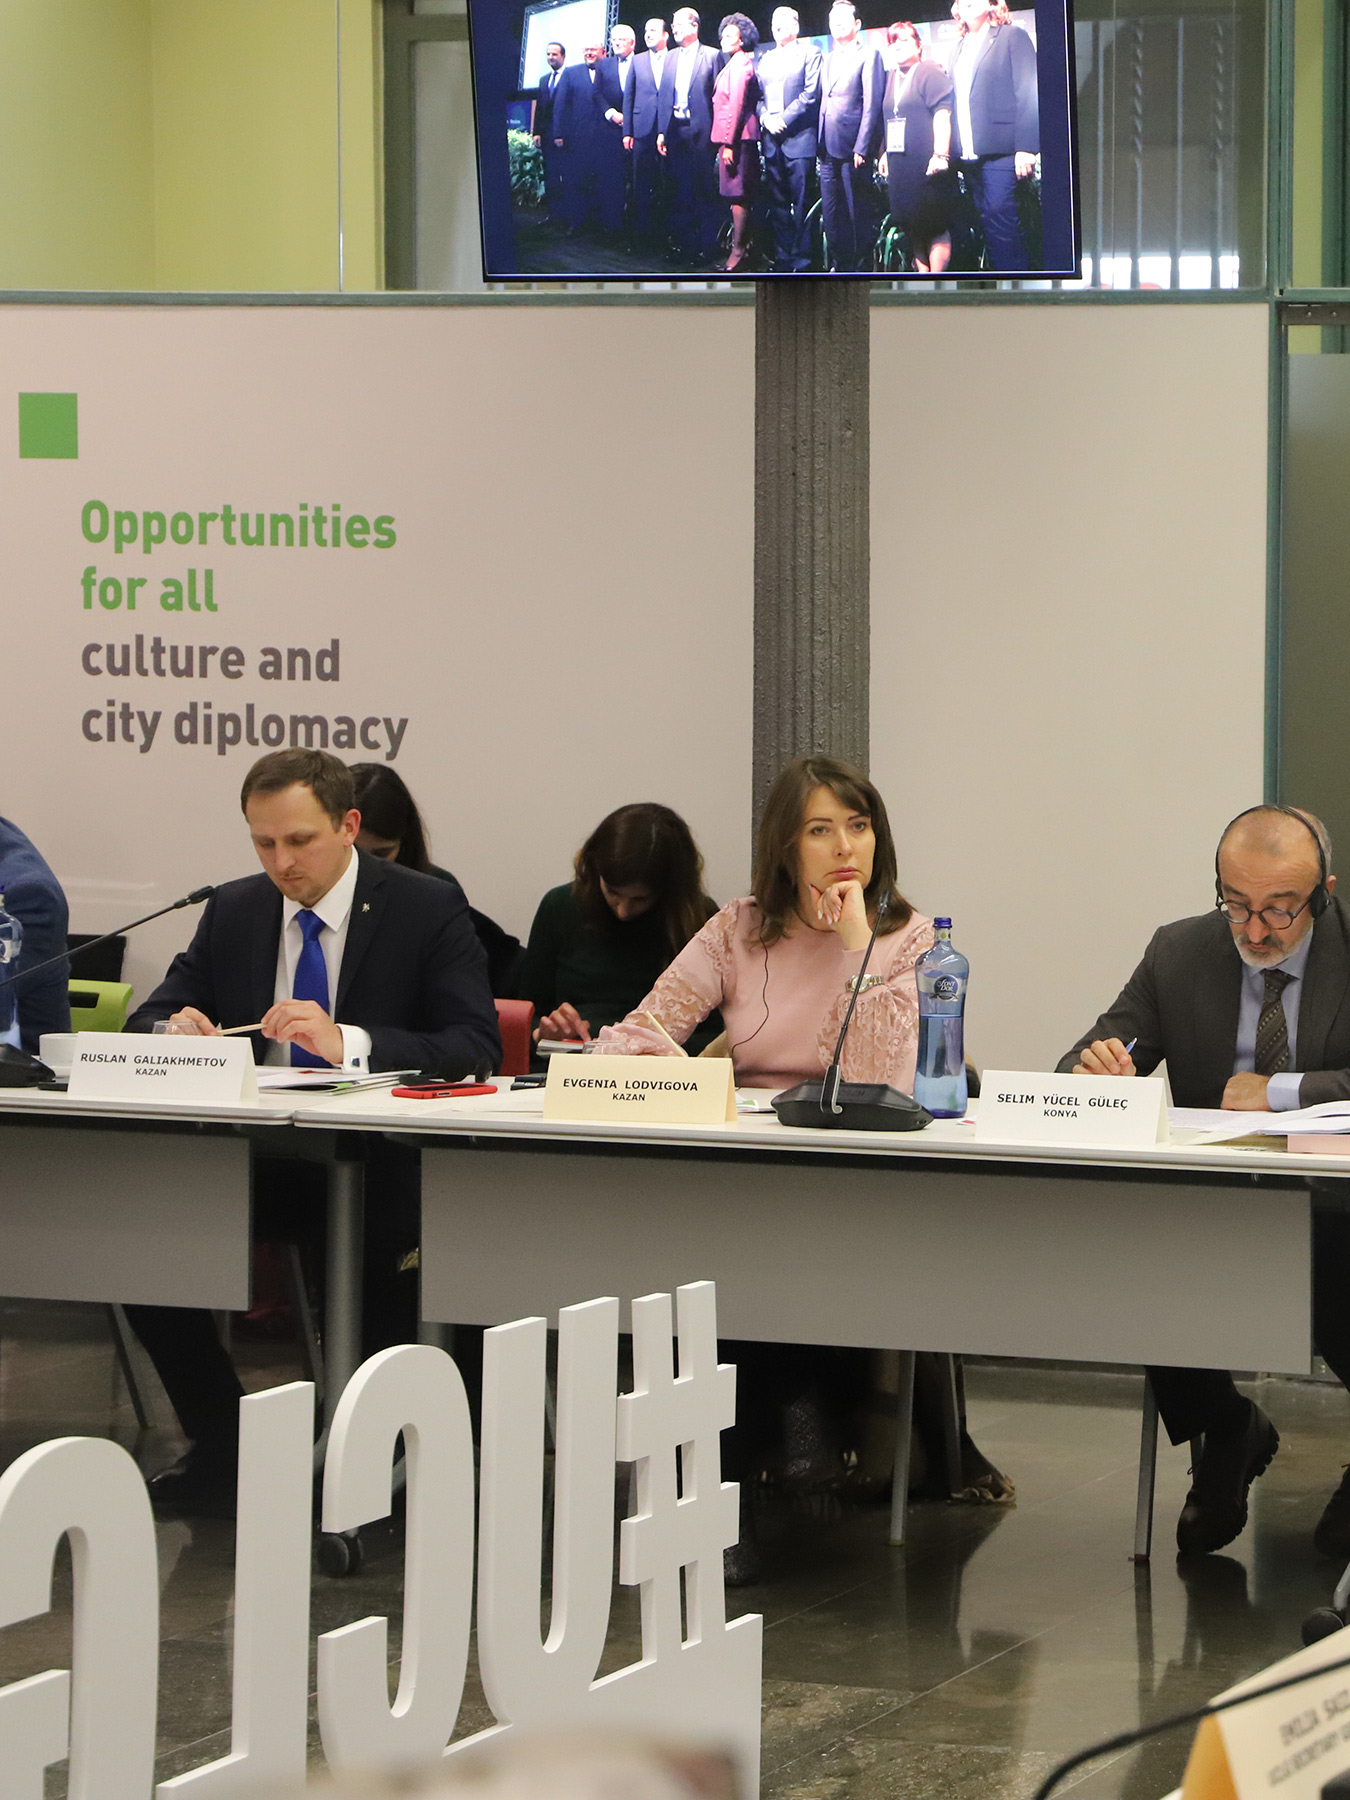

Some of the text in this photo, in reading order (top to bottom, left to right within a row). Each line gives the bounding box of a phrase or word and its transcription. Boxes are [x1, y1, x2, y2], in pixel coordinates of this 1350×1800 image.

[81, 499, 398, 554] Opportunities
[80, 565, 219, 613] for all
[81, 633, 340, 682] culture and
[81, 698, 409, 761] city diplomacy
[80, 1053, 227, 1068] RUSLAN GALIAKHMETOV
[135, 1067, 168, 1077] KAZAN
[563, 1078, 699, 1092] EVGENIA LODVIGOVA
[612, 1093, 647, 1102] KAZAN
[997, 1093, 1129, 1111] SELIM YÜCEL GÜLEÇ
[1043, 1109, 1079, 1119] KONYA
